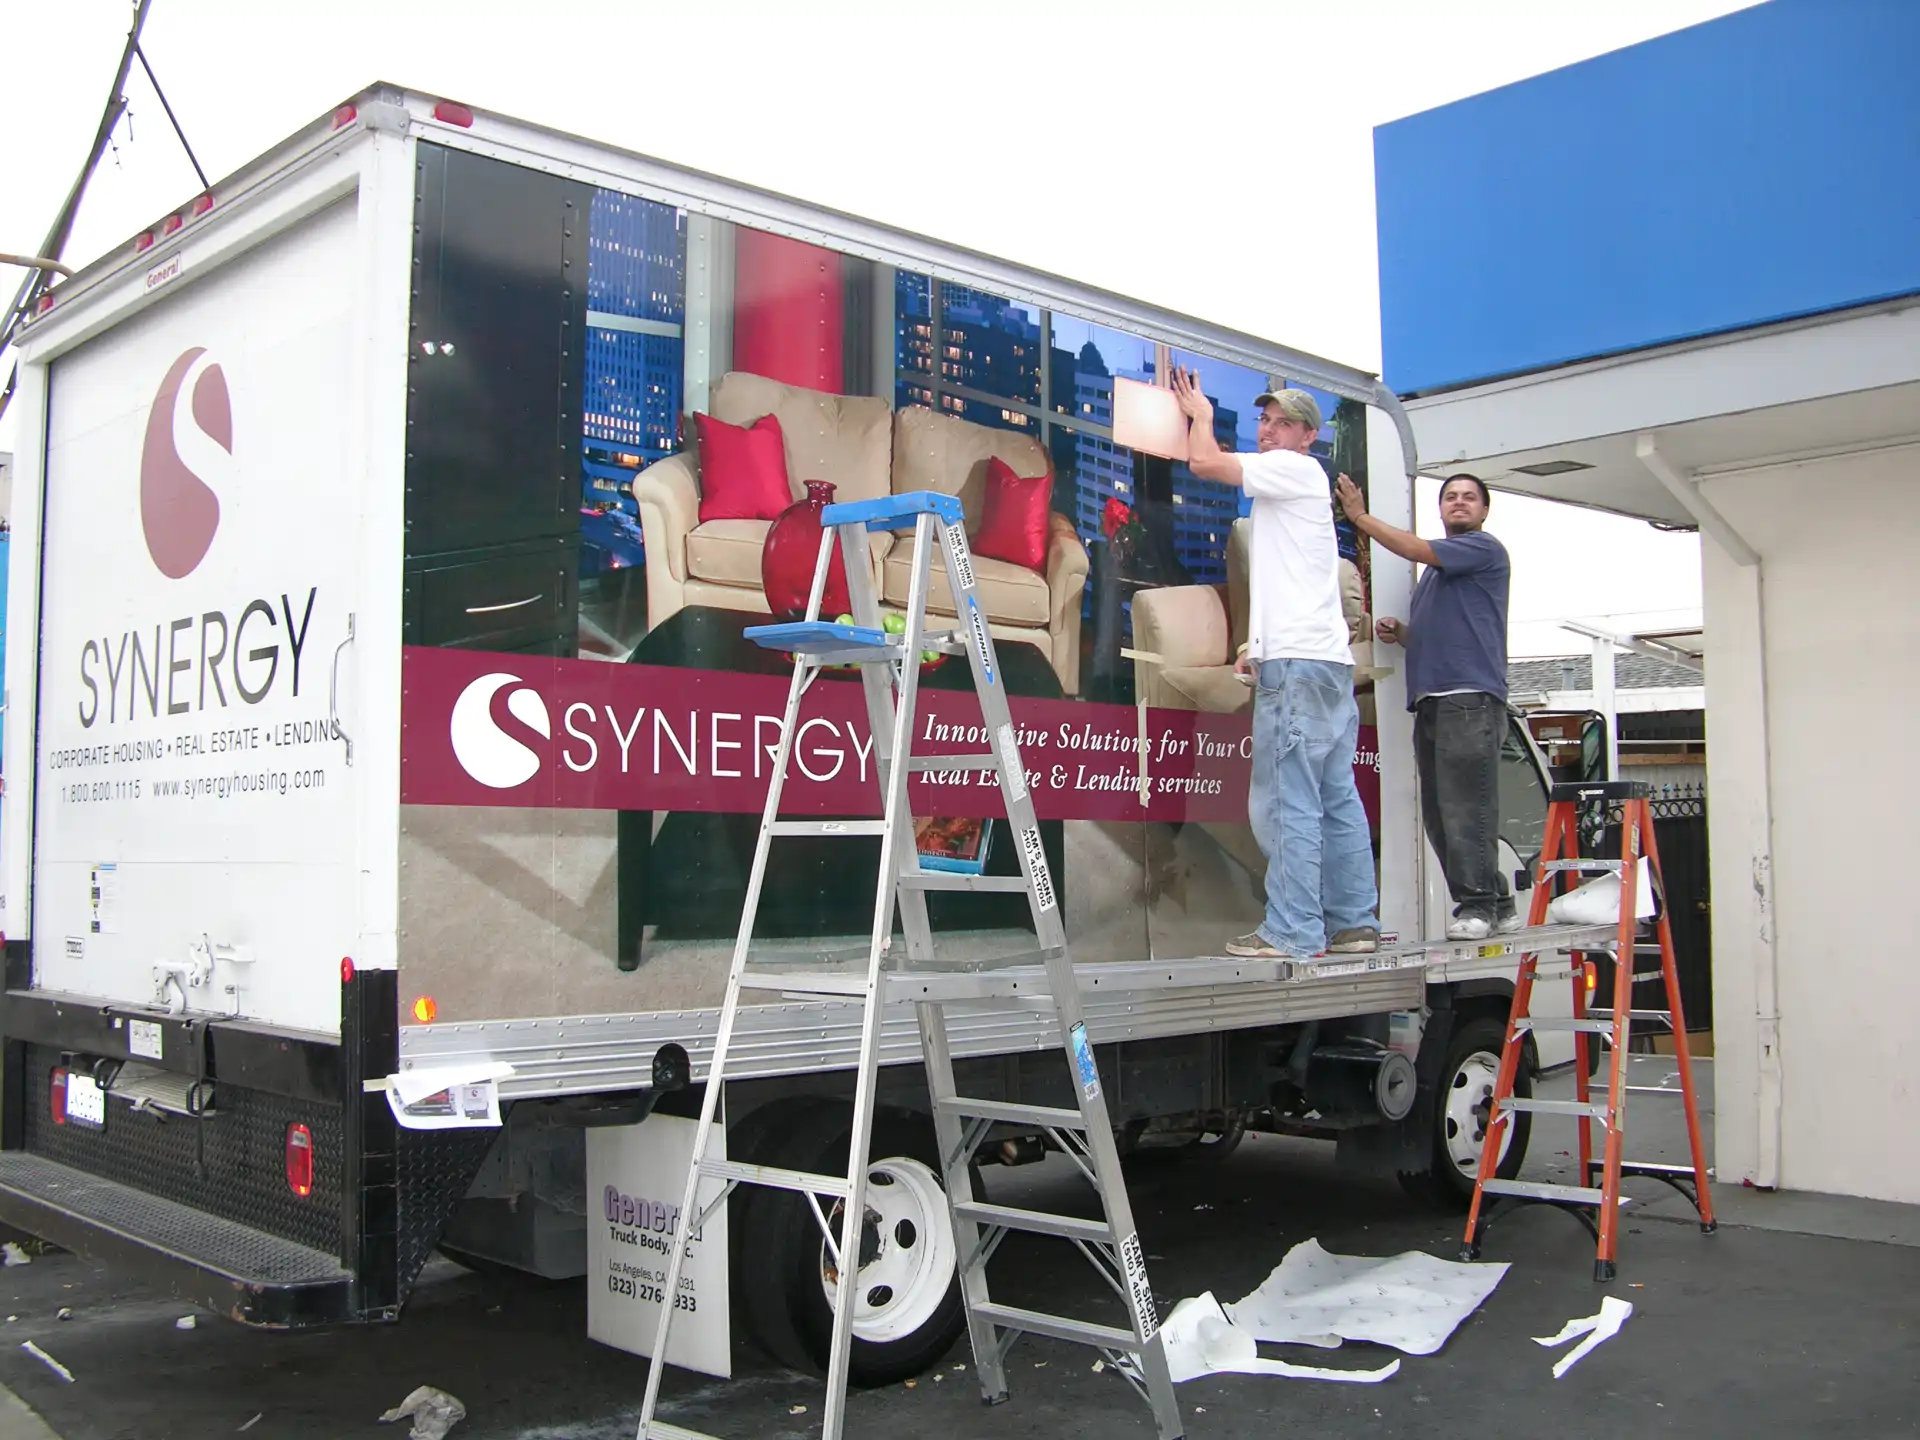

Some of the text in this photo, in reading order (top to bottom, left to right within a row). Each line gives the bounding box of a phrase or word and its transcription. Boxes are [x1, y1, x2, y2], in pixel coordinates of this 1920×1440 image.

[147, 259, 178, 288] General
[961, 557, 974, 585] SIGNS
[79, 587, 317, 728] SYNERGY
[972, 613, 990, 667] WERNER
[50, 745, 109, 769] CORPORATE
[113, 739, 163, 763] HOUSING
[176, 733, 205, 757] REAL
[211, 727, 258, 752] ESTATE
[562, 702, 874, 782] SYNERGY
[923, 713, 1048, 748] Innovive
[1155, 729, 1189, 762] for
[1196, 732, 1235, 758] Your
[62, 768, 325, 803] 1.800.600.1115 www.synergyhousing.com
[977, 768, 1041, 788] Este
[1050, 764, 1068, 789] &
[1157, 772, 1222, 794] services
[1022, 828, 1047, 907] 510) 481-1700
[1029, 828, 1053, 904] AM'S SIGNS
[604, 1184, 703, 1242] Generl
[609, 1226, 638, 1246] Truck
[640, 1233, 671, 1255] Body,
[608, 1274, 637, 1299] (323)
[609, 1258, 622, 1272] Los
[622, 1262, 654, 1282] Angeles,
[655, 1270, 667, 1283] CA
[1122, 1241, 1151, 1338] (510) 481-1700
[1129, 1234, 1159, 1333] SAM'S SIGNS
